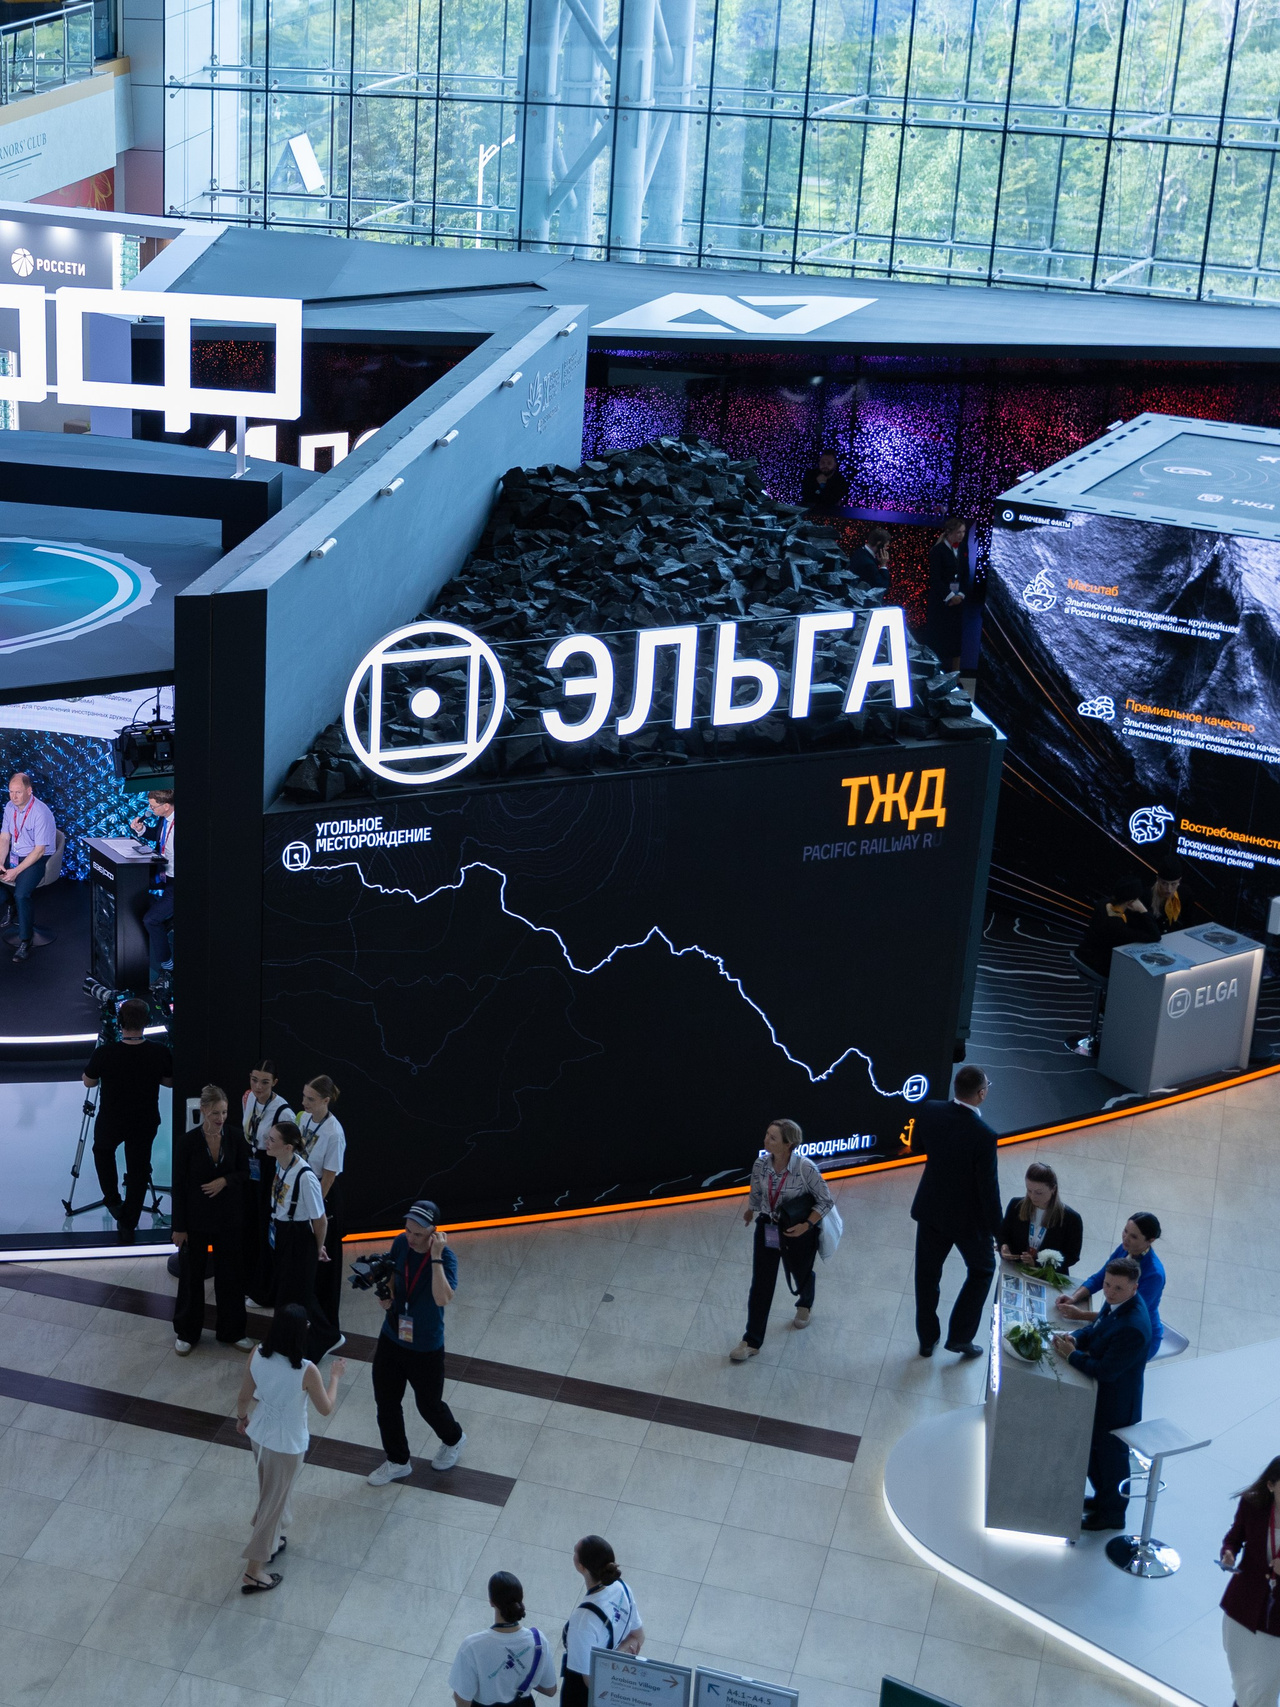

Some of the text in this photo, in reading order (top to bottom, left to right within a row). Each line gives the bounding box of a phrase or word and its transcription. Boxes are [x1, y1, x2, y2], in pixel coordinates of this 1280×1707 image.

[27, 132, 47, 156] CLUB
[36, 258, 86, 276] РОССЕТИ
[1019, 514, 1071, 528] КЛЮЧЕВЫЕ ФАКТЫ
[1067, 578, 1119, 597] Масштаб
[1065, 596, 1112, 614] Эльгинское
[1112, 605, 1178, 623] месторождение
[1188, 617, 1240, 635] крупнейшее
[1070, 606, 1100, 619] России
[1107, 614, 1127, 626] одно
[1128, 617, 1137, 626] из
[1138, 617, 1190, 636] крупнейших
[1198, 628, 1220, 640] мире
[540, 606, 913, 743] ЭЛЬГА
[1125, 698, 1255, 733] Премиальное качество
[1123, 717, 1171, 734] Эльгинский
[1171, 727, 1196, 739] уголь
[1196, 732, 1256, 750] премиального
[1127, 729, 1171, 743] аномально
[1173, 737, 1205, 749] низким
[1205, 742, 1263, 762] содержанием
[841, 768, 946, 831] ТЖД
[315, 816, 383, 837] УГОЛЬНОЕ
[315, 827, 432, 852] МЕСТОРОЖДЕНИЕ
[802, 841, 857, 862] PACIFIC
[859, 834, 920, 856] RAILWAY
[1177, 836, 1223, 854] Продукция
[1224, 847, 1266, 863] компании
[1176, 846, 1254, 870] на мировом рынке
[1194, 978, 1238, 1008] ELGA
[611, 1675, 637, 1686] Arabian
[638, 1681, 661, 1691] Village
[622, 1665, 638, 1676] A2
[610, 1691, 631, 1702] Falcon
[632, 1697, 652, 1706] House
[725, 1696, 758, 1707] Meeting
